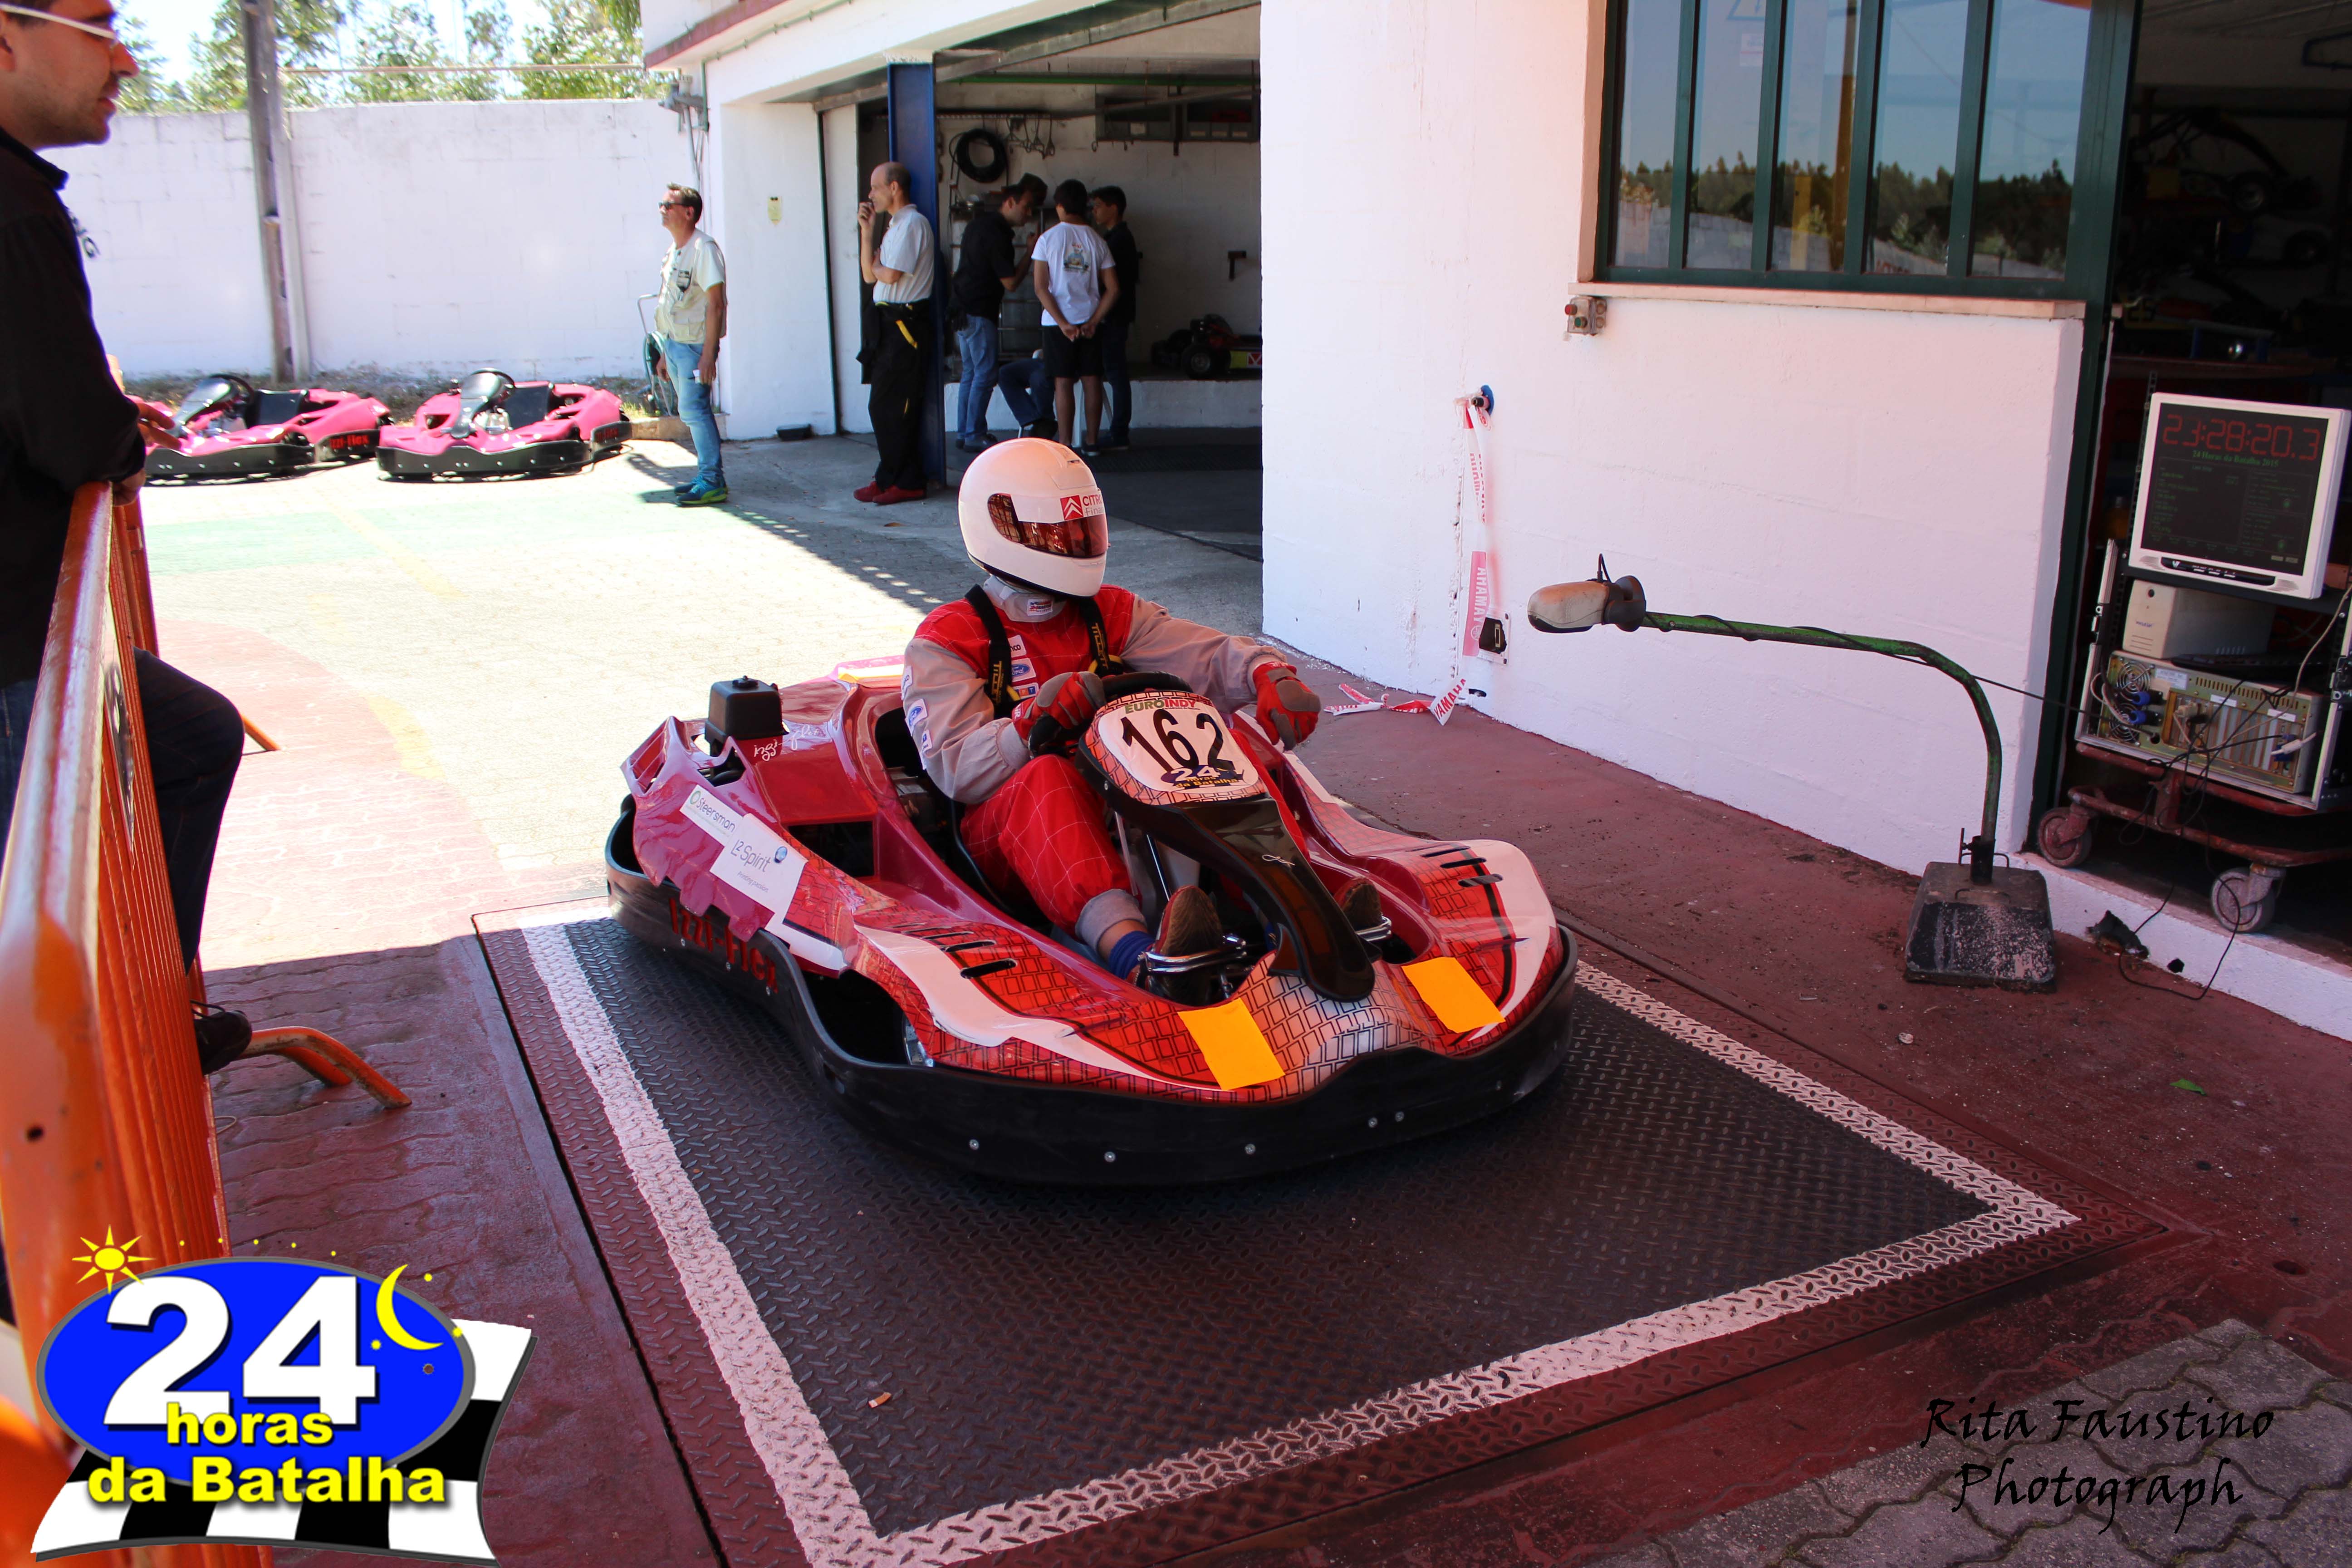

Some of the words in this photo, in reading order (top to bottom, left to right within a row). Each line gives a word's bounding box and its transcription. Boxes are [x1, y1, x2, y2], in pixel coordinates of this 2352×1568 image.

[2162, 413, 2321, 461] 23:28:20.3
[1125, 699, 1196, 714] EUROINDY
[1120, 709, 1236, 772] 162
[1171, 765, 1221, 782] 24
[1193, 778, 1238, 786] Batalha
[696, 797, 736, 833] Steersman
